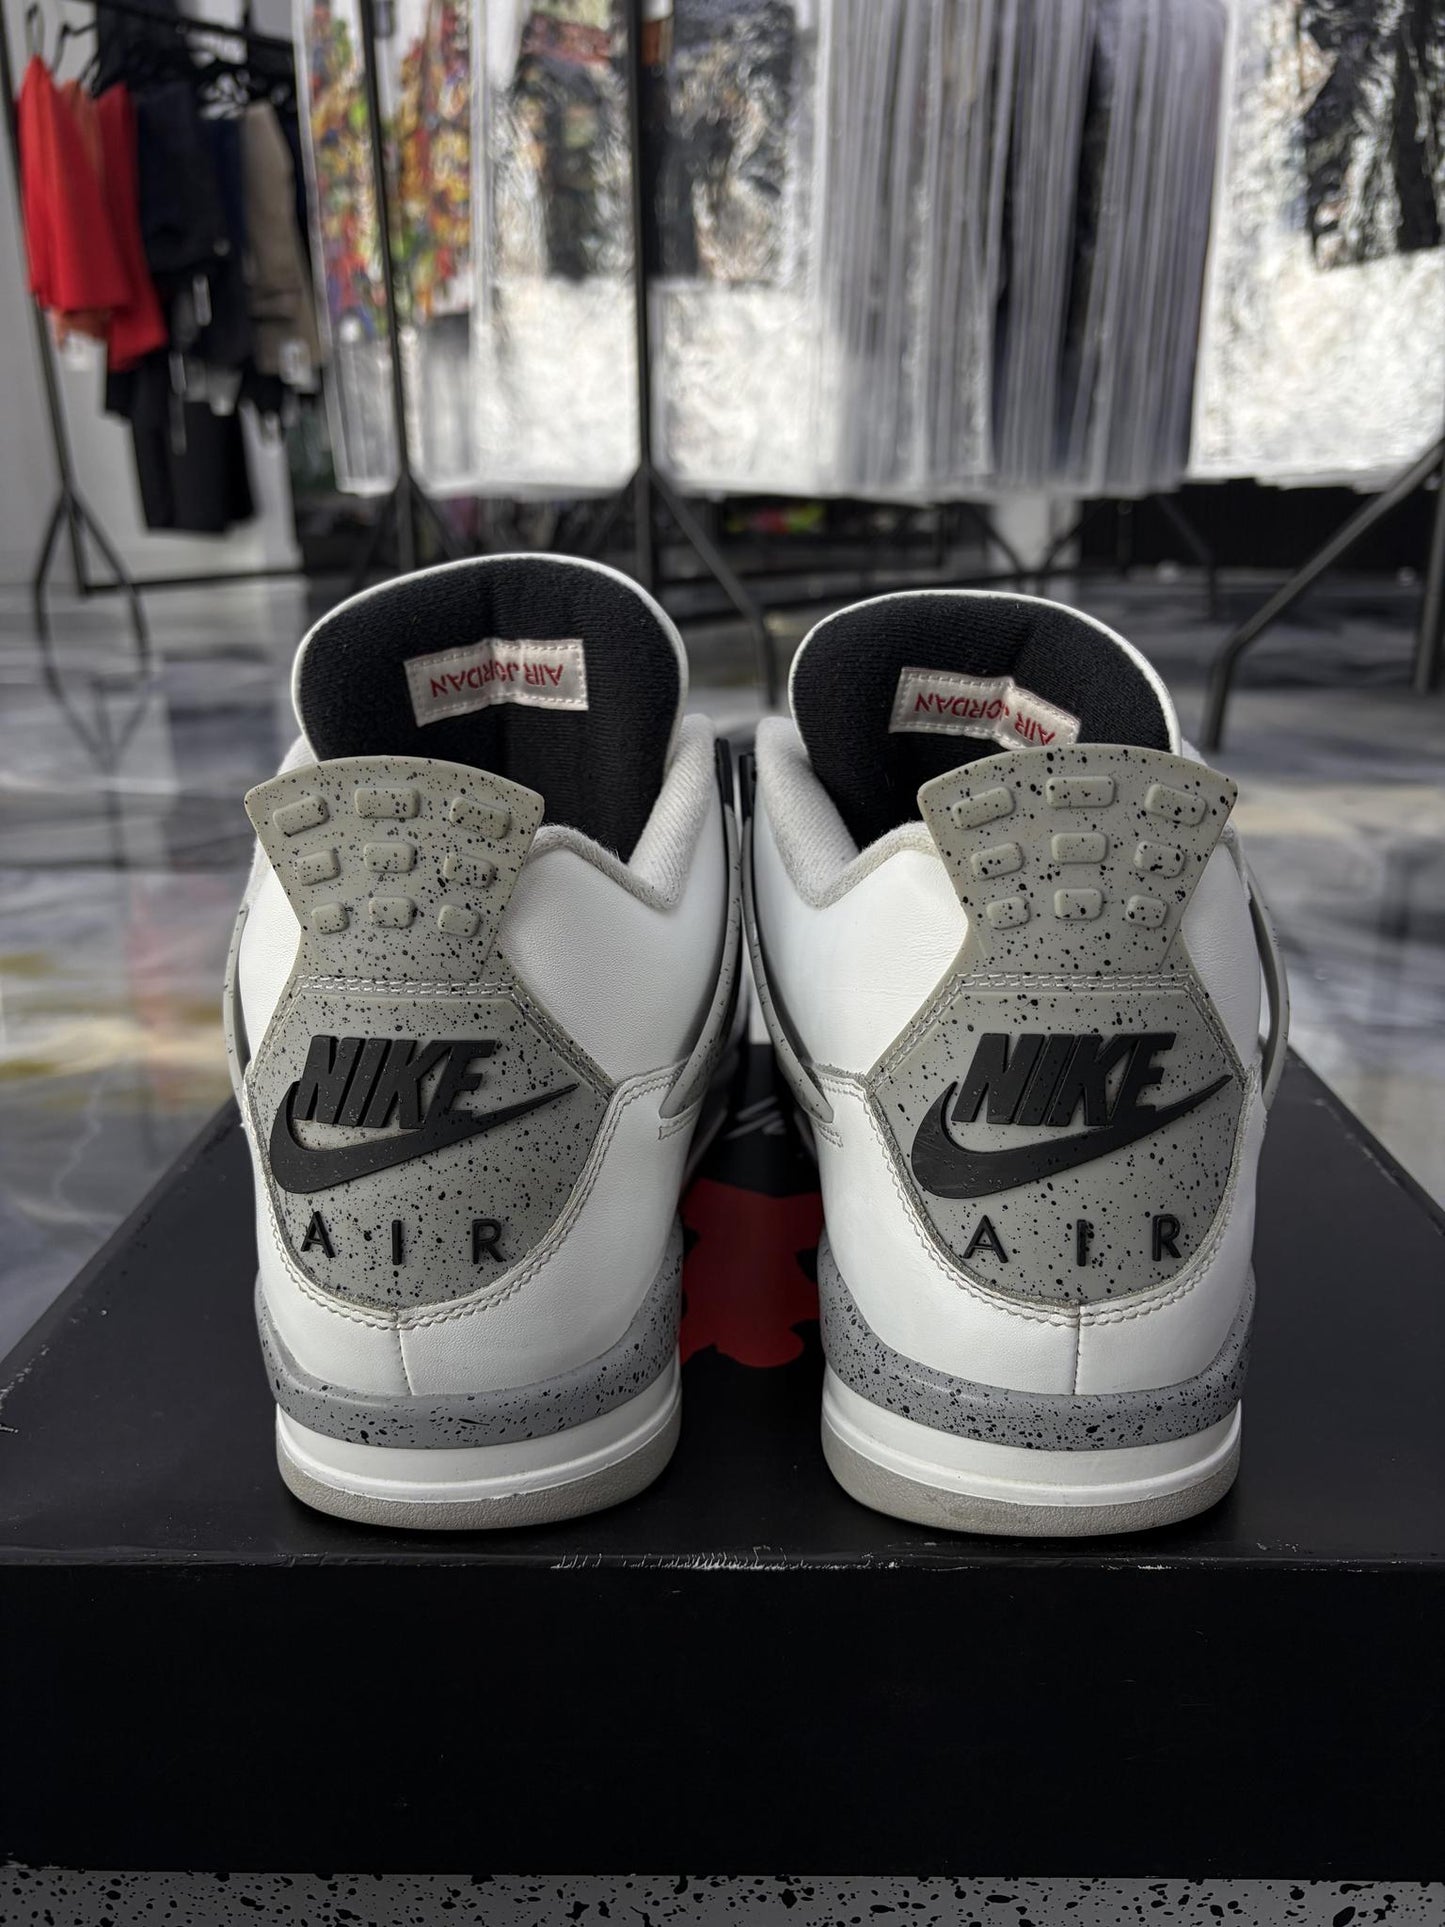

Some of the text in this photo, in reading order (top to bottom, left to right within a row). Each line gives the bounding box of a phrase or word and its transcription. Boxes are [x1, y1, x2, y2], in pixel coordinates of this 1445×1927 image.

[430, 660, 563, 698] AIR JORDAN
[1014, 712, 1056, 746] AIR
[292, 1034, 497, 1130] NIKE
[951, 1032, 1177, 1127] NIKE
[300, 1211, 507, 1266] AIR
[963, 1214, 1182, 1267] AIR
